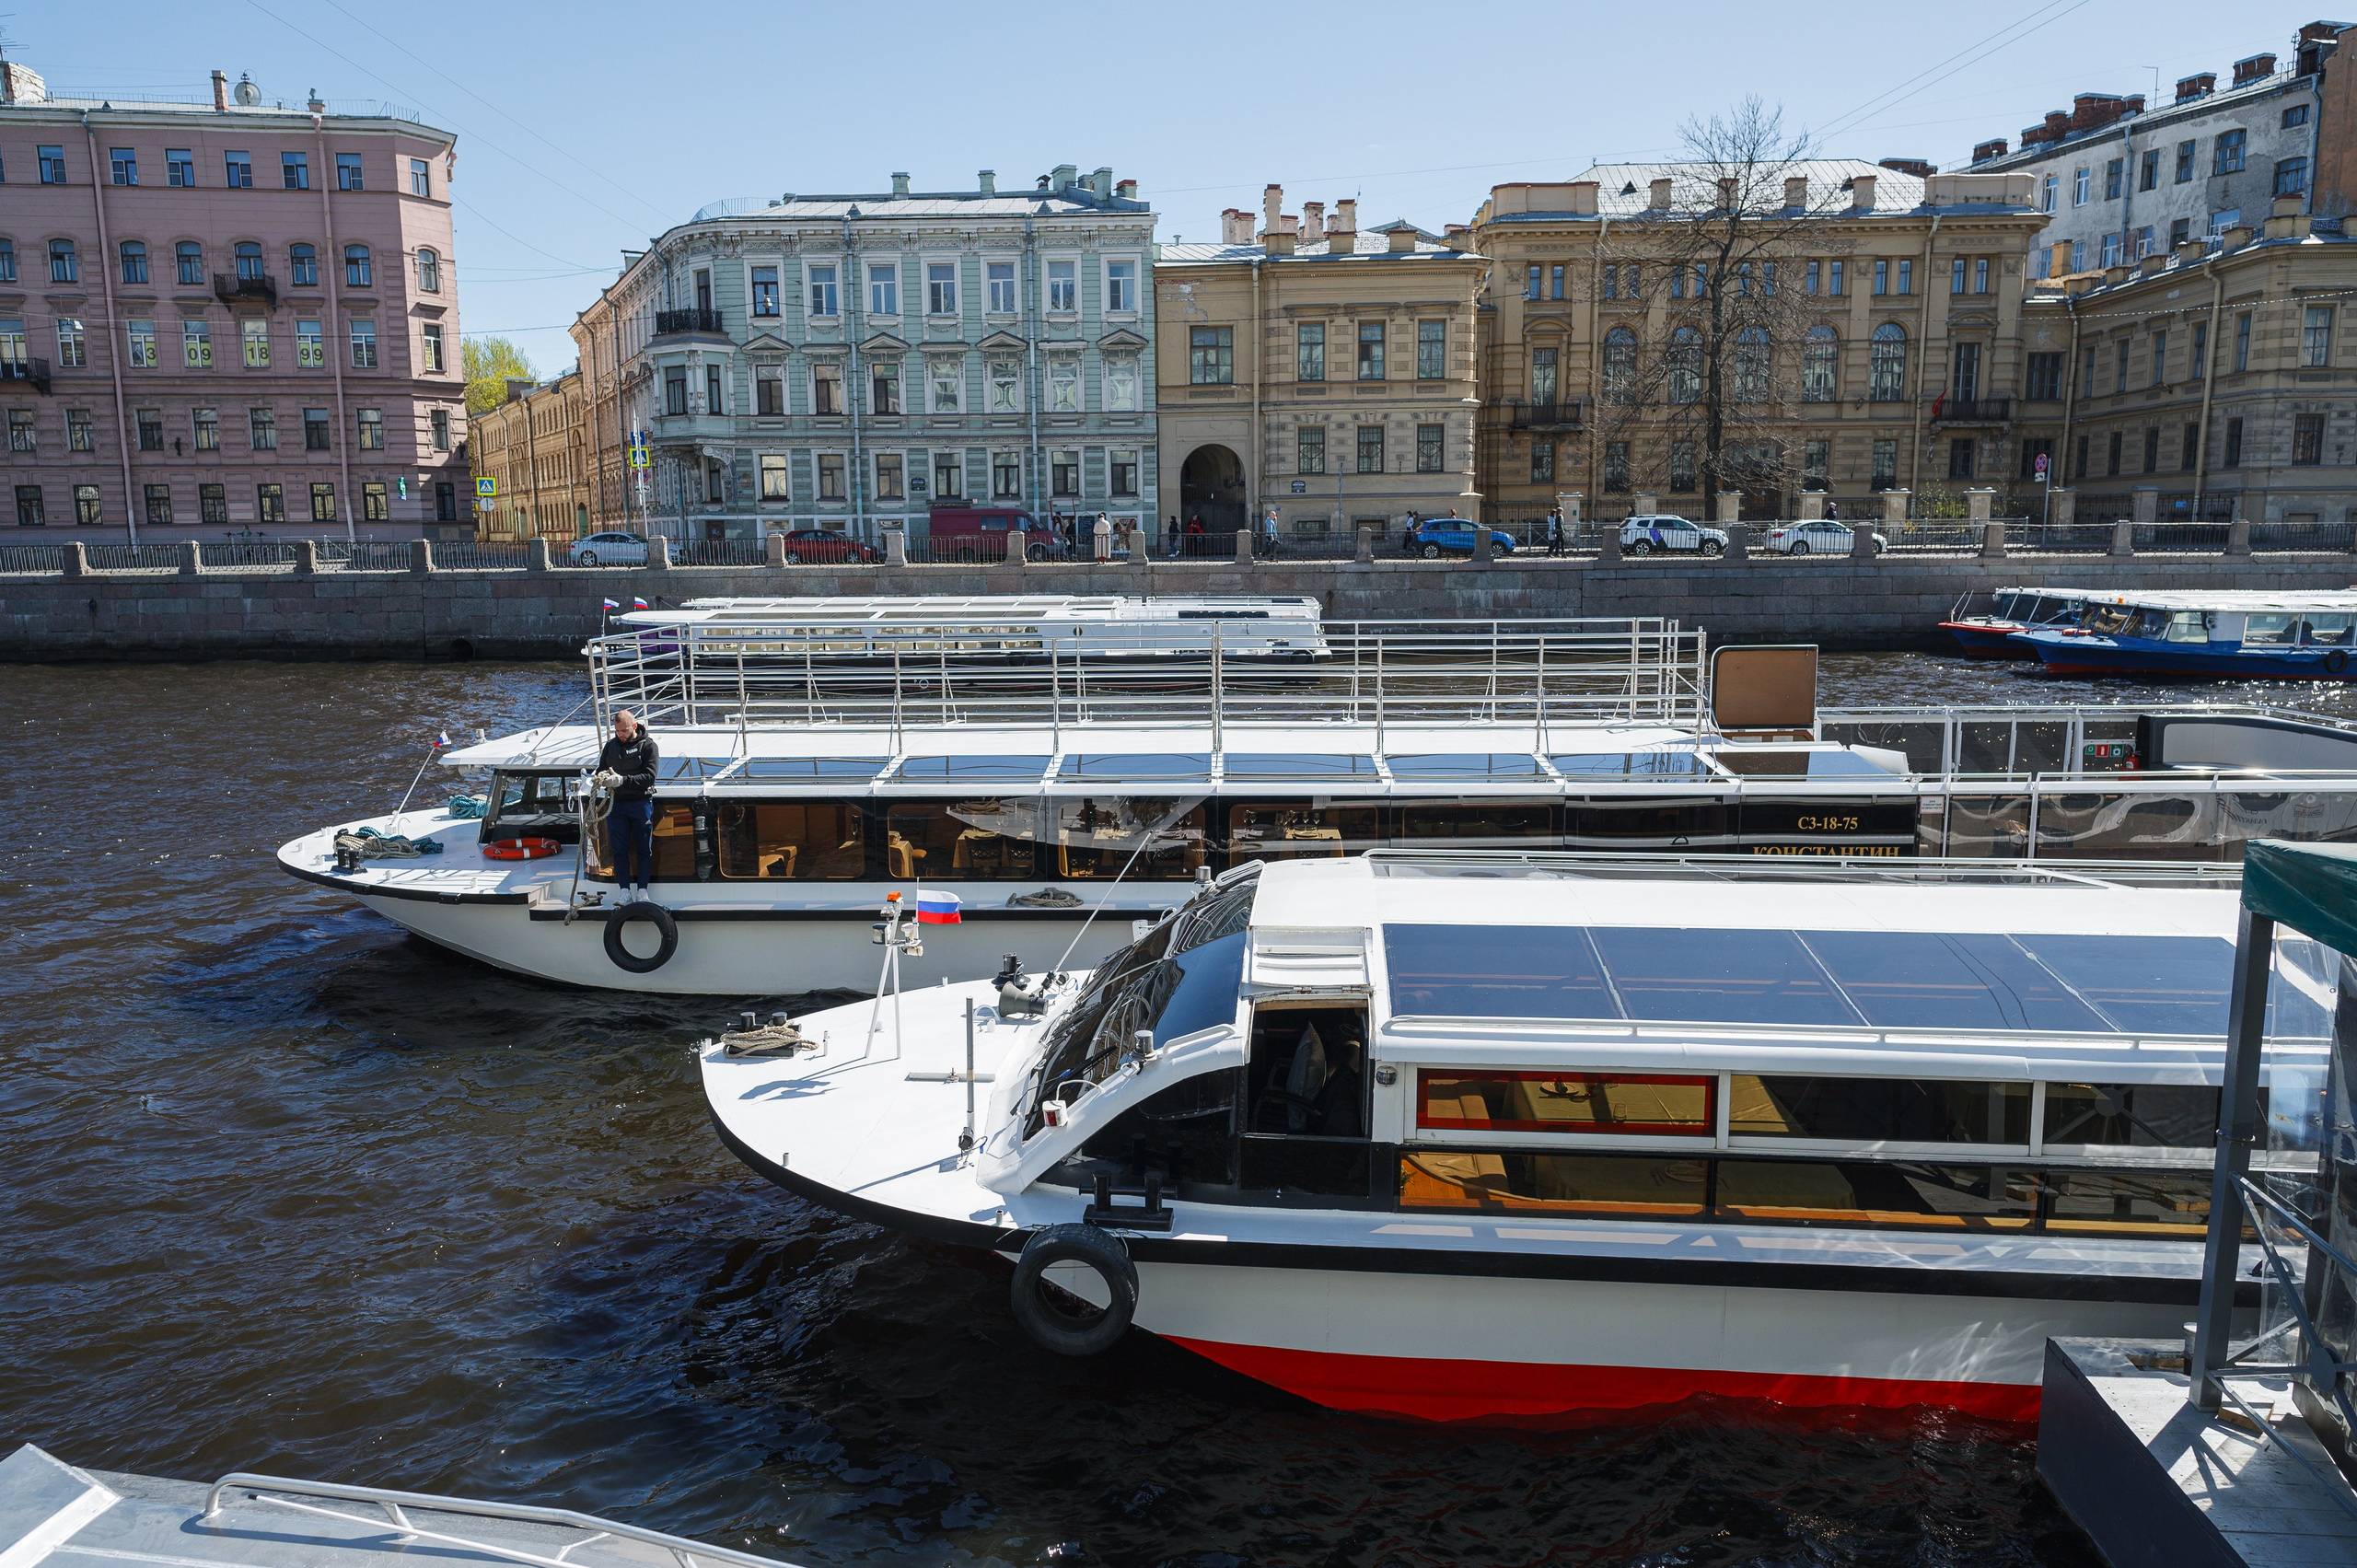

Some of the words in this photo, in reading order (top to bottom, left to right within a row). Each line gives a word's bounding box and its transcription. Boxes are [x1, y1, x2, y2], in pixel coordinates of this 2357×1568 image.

[146, 347, 157, 361] 3
[188, 347, 212, 361] 09
[248, 346, 270, 361] 18
[300, 347, 324, 361] 99
[1752, 846, 1900, 857] КОНСТАНТИН
